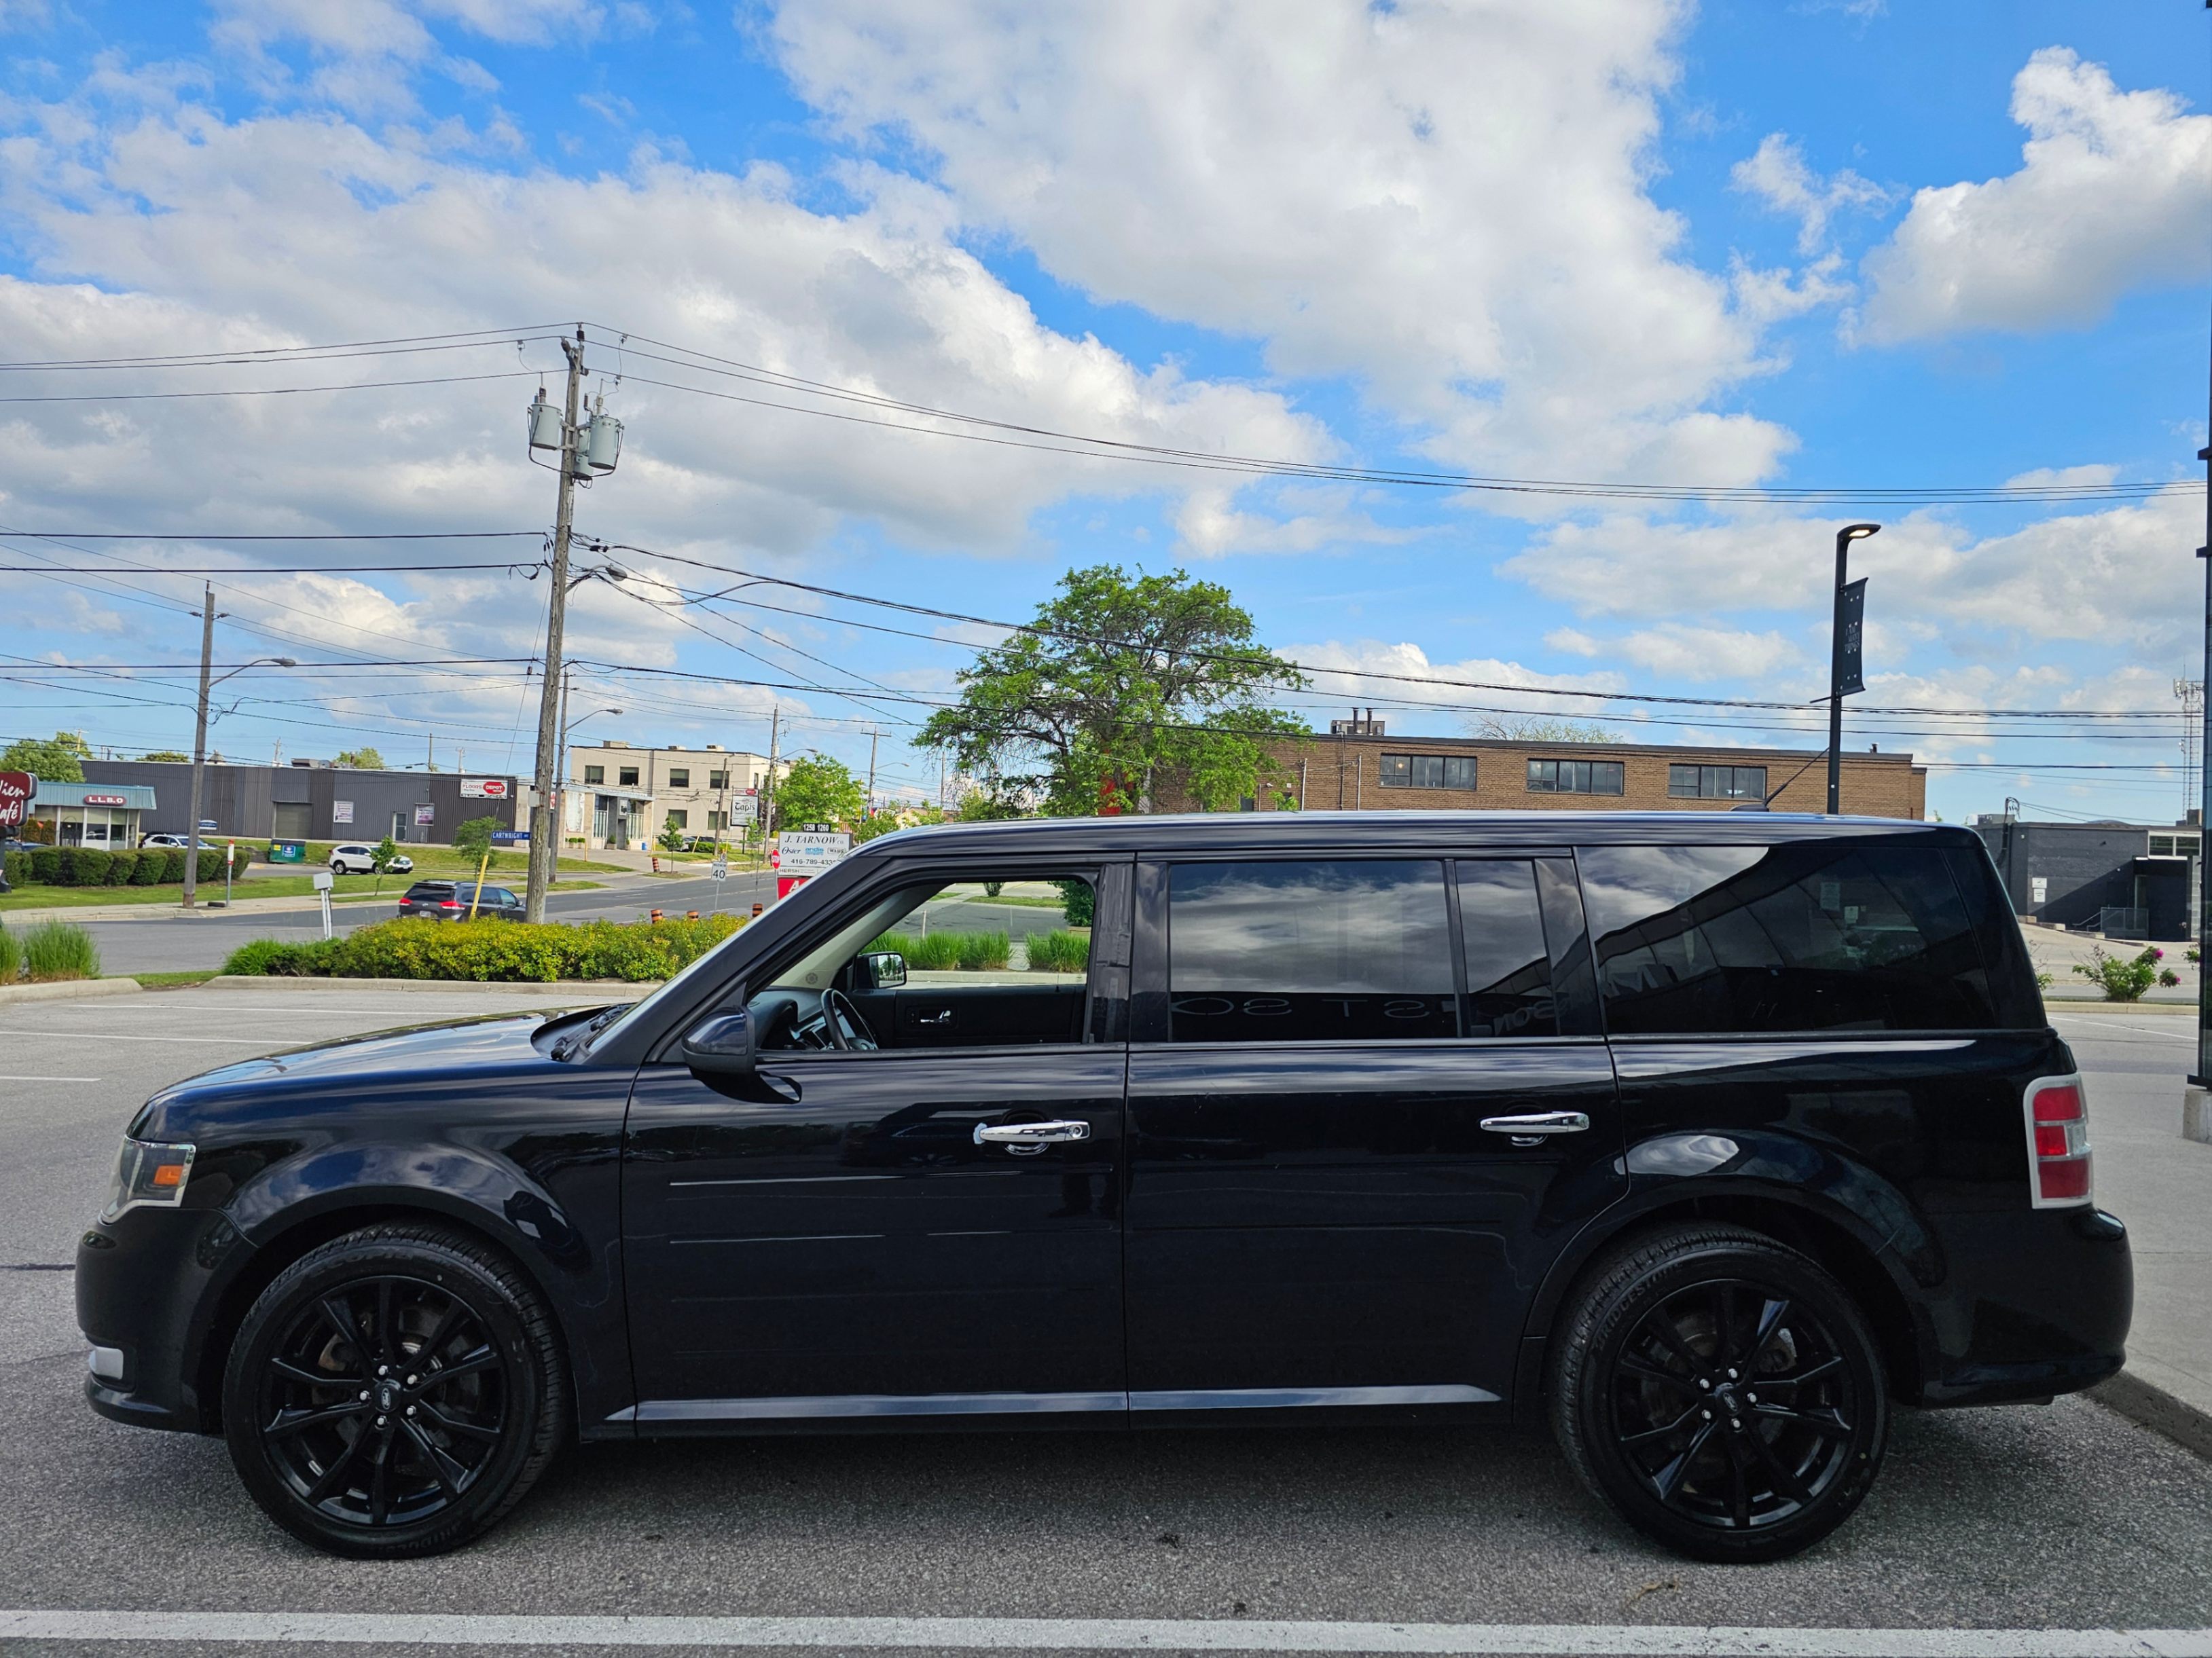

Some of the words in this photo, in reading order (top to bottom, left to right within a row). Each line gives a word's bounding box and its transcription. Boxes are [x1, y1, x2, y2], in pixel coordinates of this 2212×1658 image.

[735, 802, 755, 812] Tapis
[0, 800, 19, 825] afé
[803, 824, 816, 832] 1258
[784, 835, 793, 843] J.
[795, 835, 838, 844] TARNOW
[782, 846, 801, 854] Oster
[712, 869, 725, 879] 40
